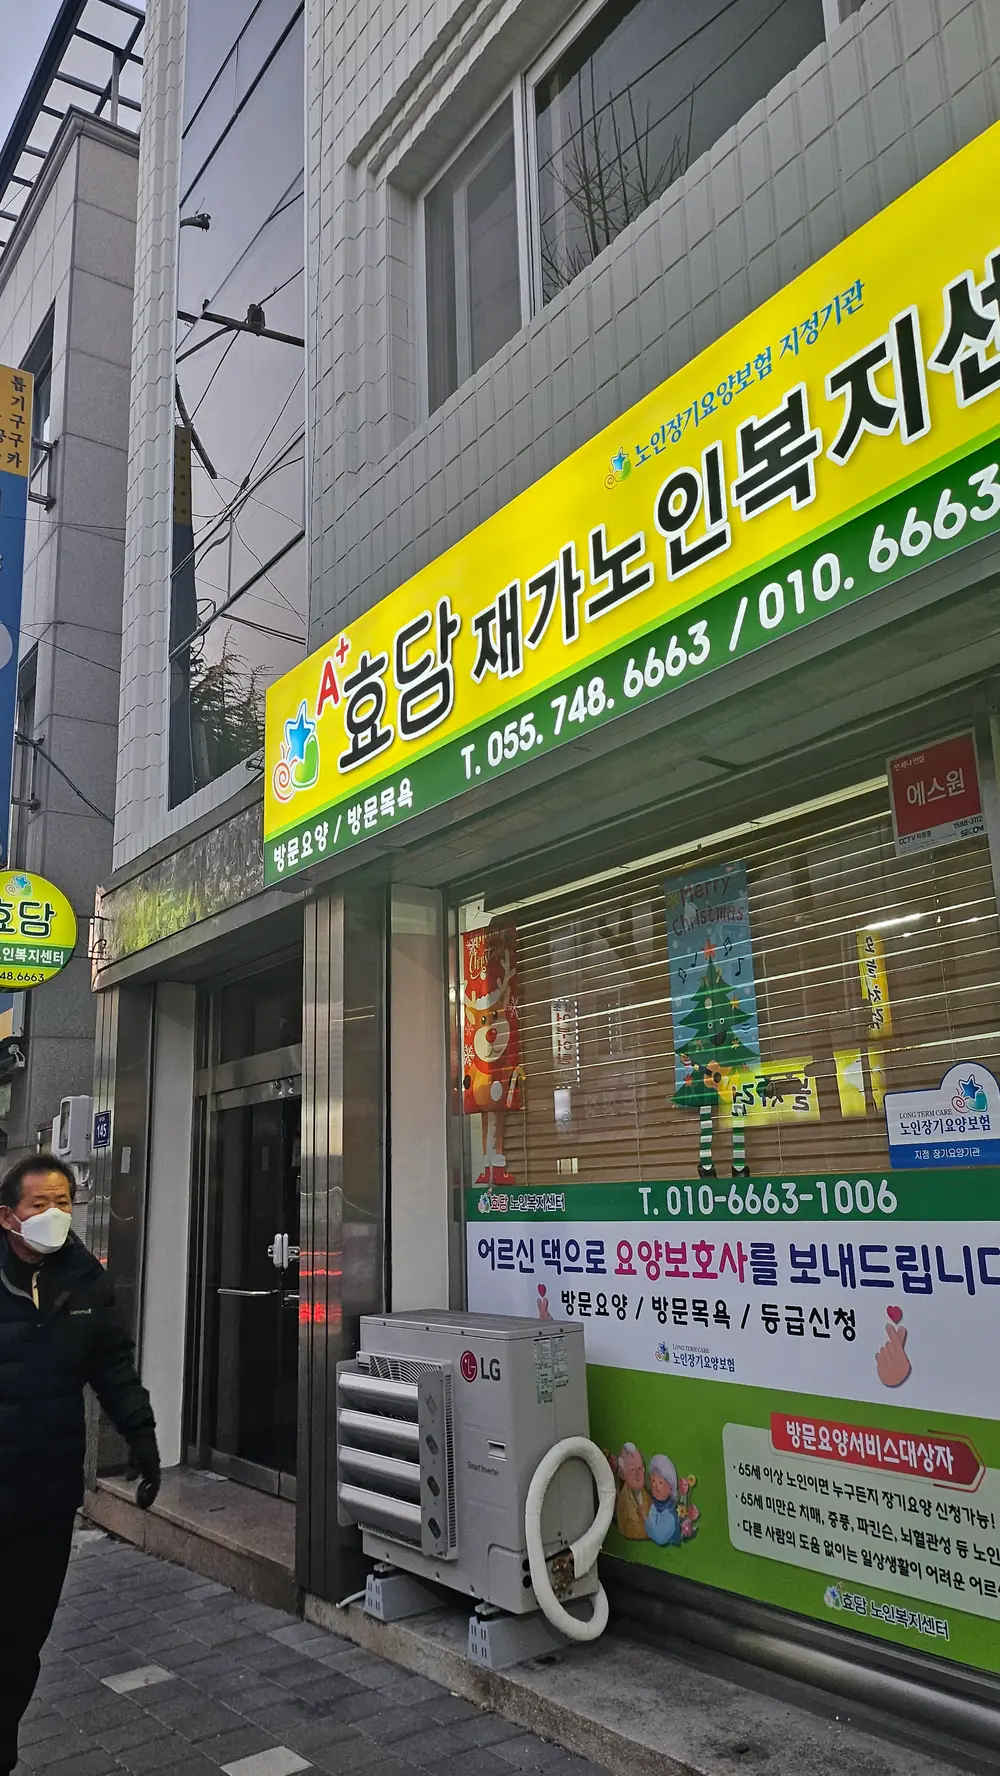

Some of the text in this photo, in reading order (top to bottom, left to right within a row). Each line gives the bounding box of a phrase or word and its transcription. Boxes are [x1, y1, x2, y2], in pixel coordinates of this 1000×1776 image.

[635, 278, 865, 467] 노인장기요양보험 지정기관
[460, 744, 481, 780] T.
[487, 713, 544, 767] 055.
[550, 676, 615, 735] 748.
[623, 619, 711, 699] 6663
[758, 552, 854, 630] 010.
[868, 463, 1000, 573] 6663
[339, 598, 459, 772] 효담
[906, 767, 966, 806] 에스원
[273, 777, 413, 872] 방문요양 / 방문목욕
[899, 835, 916, 845] CCTV
[953, 815, 983, 829] 1588-3112
[960, 825, 984, 837] SECOM
[0, 947, 64, 965] 인복지센터
[899, 1108, 952, 1119] LONG TERM CARE
[900, 1114, 991, 1136] 노인장기요양보험
[914, 1147, 981, 1160] 지정 장기요양기관
[491, 1192, 565, 1212] 효담 노인복지센터
[638, 1179, 898, 1216] T. 010-6663-1006
[477, 1238, 535, 1274] 어르신
[541, 1238, 607, 1275] 댁으로
[614, 1239, 778, 1286] 요양보호사를
[561, 1289, 628, 1321] 방문요양
[652, 1296, 731, 1330] 방문목욕
[761, 1303, 856, 1341] 등급신청
[480, 1357, 501, 1381] LG
[673, 1352, 735, 1373] 노인장기요양보험
[786, 1420, 954, 1475] 방문요양서비스대상자
[467, 1461, 499, 1477] Smart Inverter
[738, 1462, 996, 1530] 65세 이상 노인이면 누구든지 장기요양 신청가능!
[740, 1492, 763, 1510] 65세
[766, 1496, 796, 1518] 미만은
[799, 1504, 825, 1526] 치매,
[828, 1510, 854, 1533] 중풍,
[857, 1517, 898, 1542] 파킨슨,
[900, 1526, 951, 1555] 뇌혈관성
[956, 1539, 968, 1559] 등
[743, 1519, 1000, 1598] 다른 사람의 도움 없이는 일상생활이 어려운 어르
[842, 1592, 950, 1641] 효담 노인복지센터
